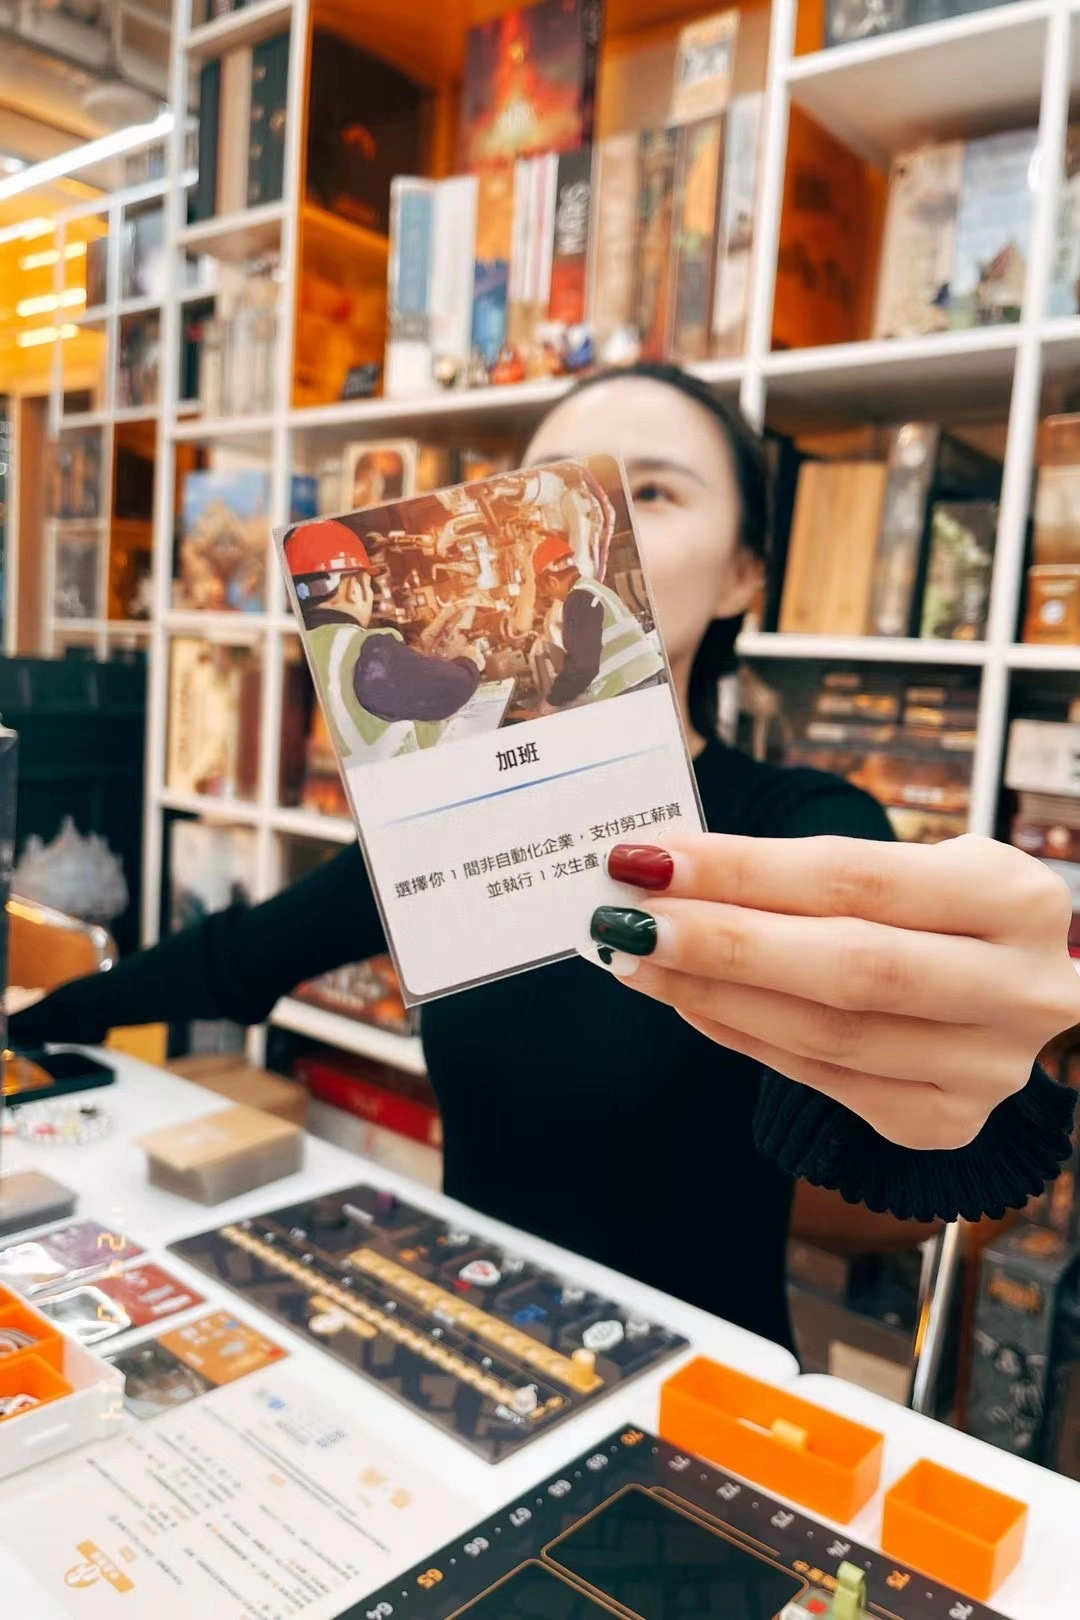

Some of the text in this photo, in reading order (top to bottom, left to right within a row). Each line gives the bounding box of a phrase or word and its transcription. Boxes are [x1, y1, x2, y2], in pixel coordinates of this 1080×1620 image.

[495, 742, 540, 772] 加班
[394, 871, 446, 898] 選擇你
[486, 871, 533, 898] 並執行
[551, 852, 607, 878] 次生產
[509, 1507, 532, 1527] 67
[463, 1536, 489, 1557] 66
[416, 1568, 444, 1589] 65
[365, 1601, 394, 1620] 64
